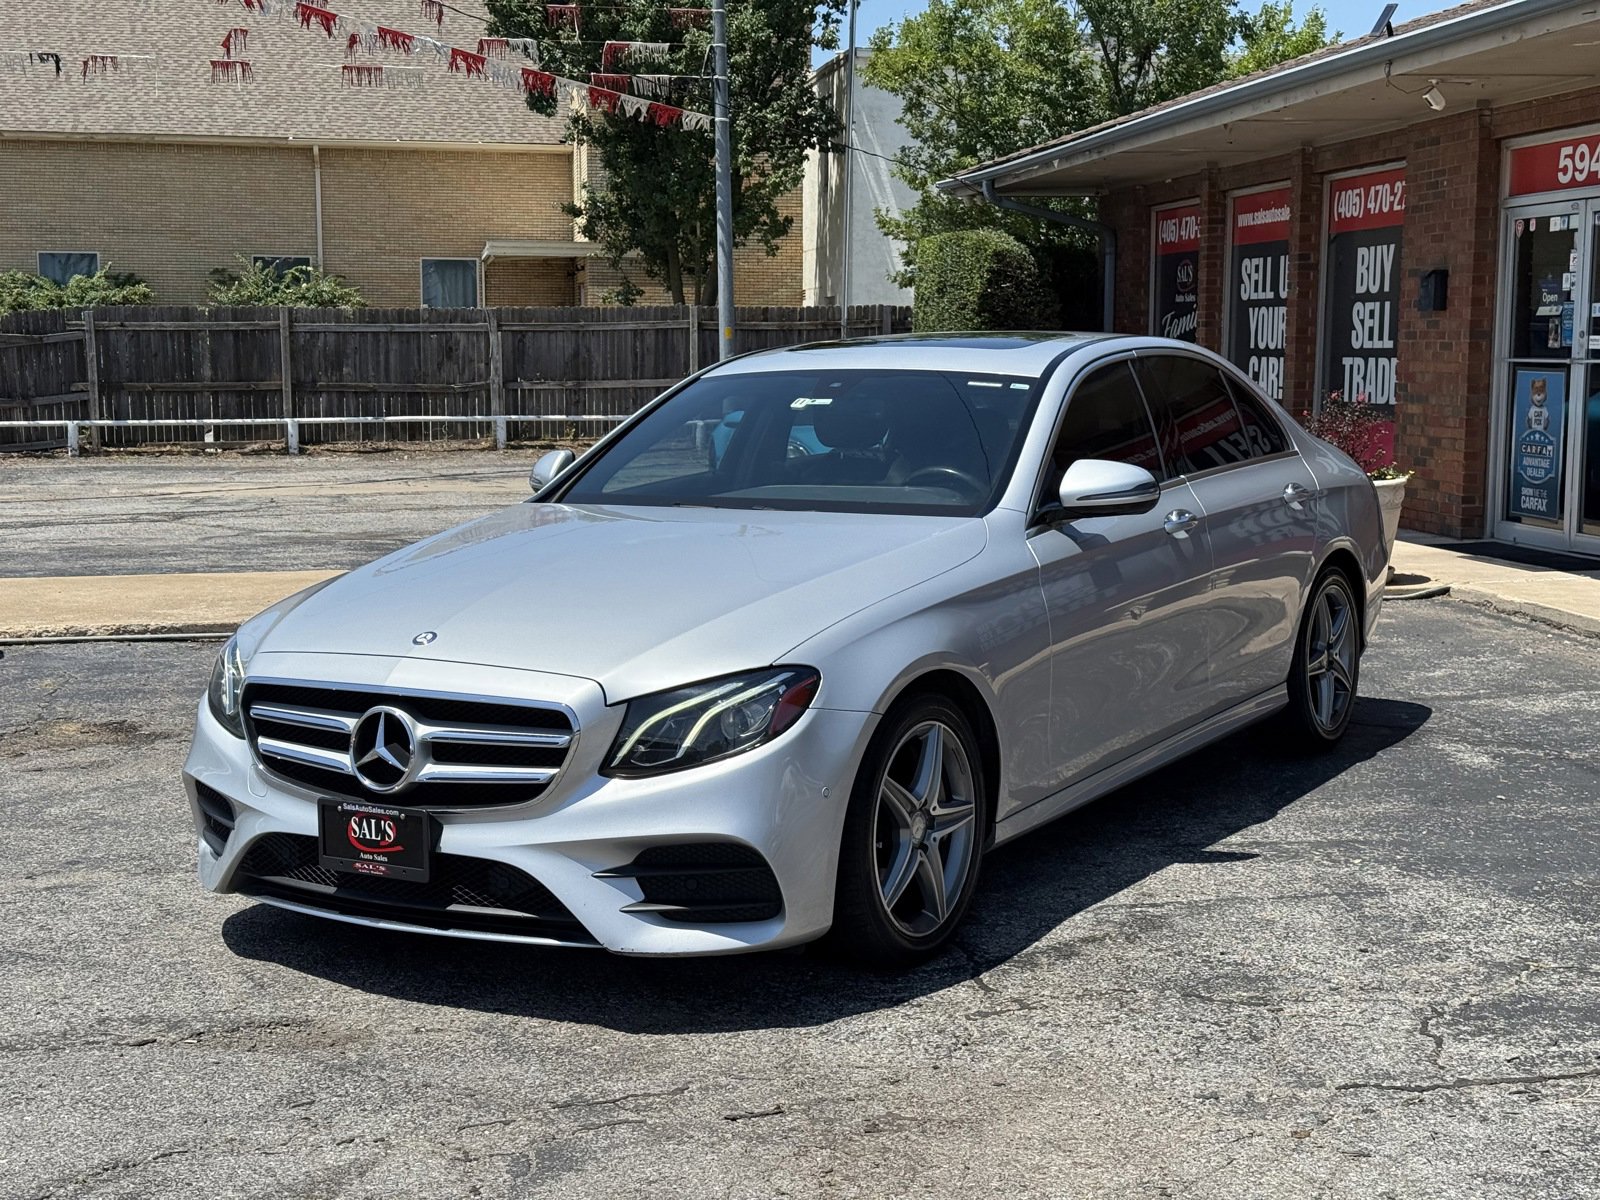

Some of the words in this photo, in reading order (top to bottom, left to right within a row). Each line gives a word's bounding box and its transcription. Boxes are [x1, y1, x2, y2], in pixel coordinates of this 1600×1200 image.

[1557, 142, 1600, 184] 594
[1334, 187, 1364, 222] (405)
[1159, 217, 1179, 245] (405)
[1240, 256, 1274, 301] SELL
[1356, 243, 1395, 294] BUY
[1542, 292, 1558, 304] Open
[1248, 306, 1287, 350] YOUR
[1351, 301, 1394, 349] SELL
[1248, 355, 1285, 400] CAR!
[1534, 410, 1543, 418] CAR
[1521, 443, 1553, 457] CARFAX
[1523, 456, 1551, 469] ADVANTAGE
[1526, 467, 1545, 478] DEALER
[1521, 495, 1548, 512] CARFAX
[343, 803, 399, 816] SalsAutoSales.com
[351, 816, 394, 842] SAL'S
[360, 852, 373, 860] Auto
[374, 853, 388, 862] Sales
